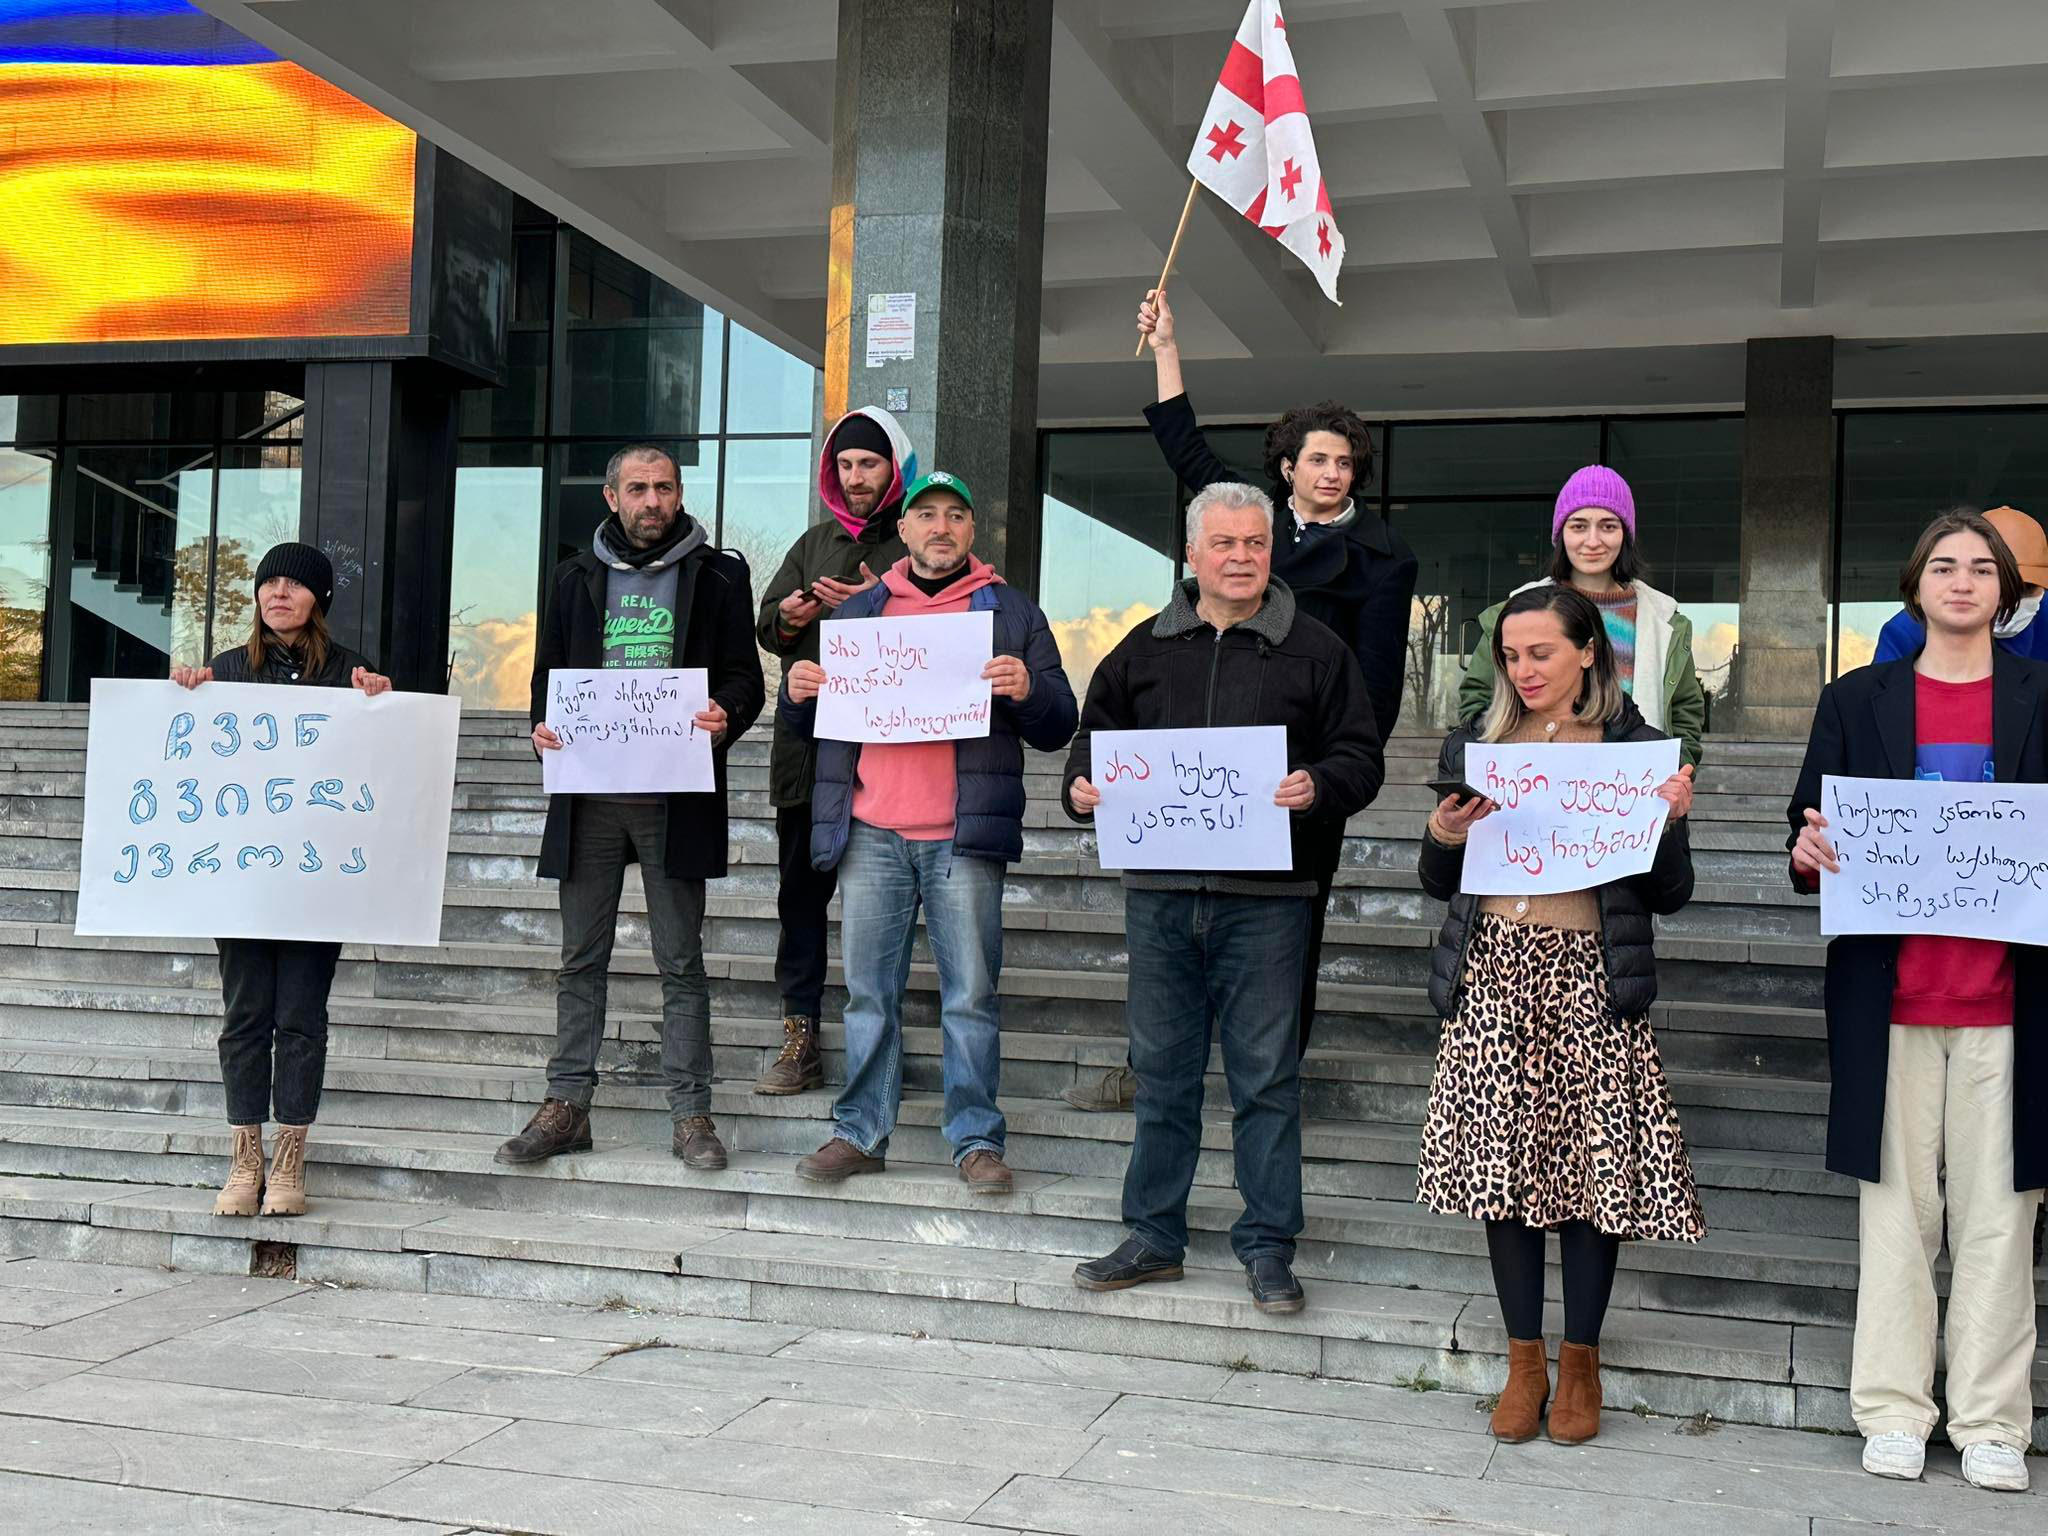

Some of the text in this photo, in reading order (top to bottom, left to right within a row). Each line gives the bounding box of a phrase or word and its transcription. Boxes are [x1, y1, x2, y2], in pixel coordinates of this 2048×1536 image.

[621, 595, 656, 608] REAL
[828, 631, 928, 670] არა რუსულ
[556, 676, 679, 714] ჩვენი არჩევანი
[165, 712, 331, 761] ჩვენ
[1105, 750, 1248, 799] არა რუსულ
[1486, 760, 1549, 809] ჩვენი
[129, 778, 374, 824] გვინდა
[1833, 784, 2026, 838] რუსული კანონი
[1126, 803, 1244, 844] კანონს!
[114, 840, 367, 883] ევროპა
[1866, 841, 1920, 866] არის
[1862, 882, 1999, 918] არჩევანი!
